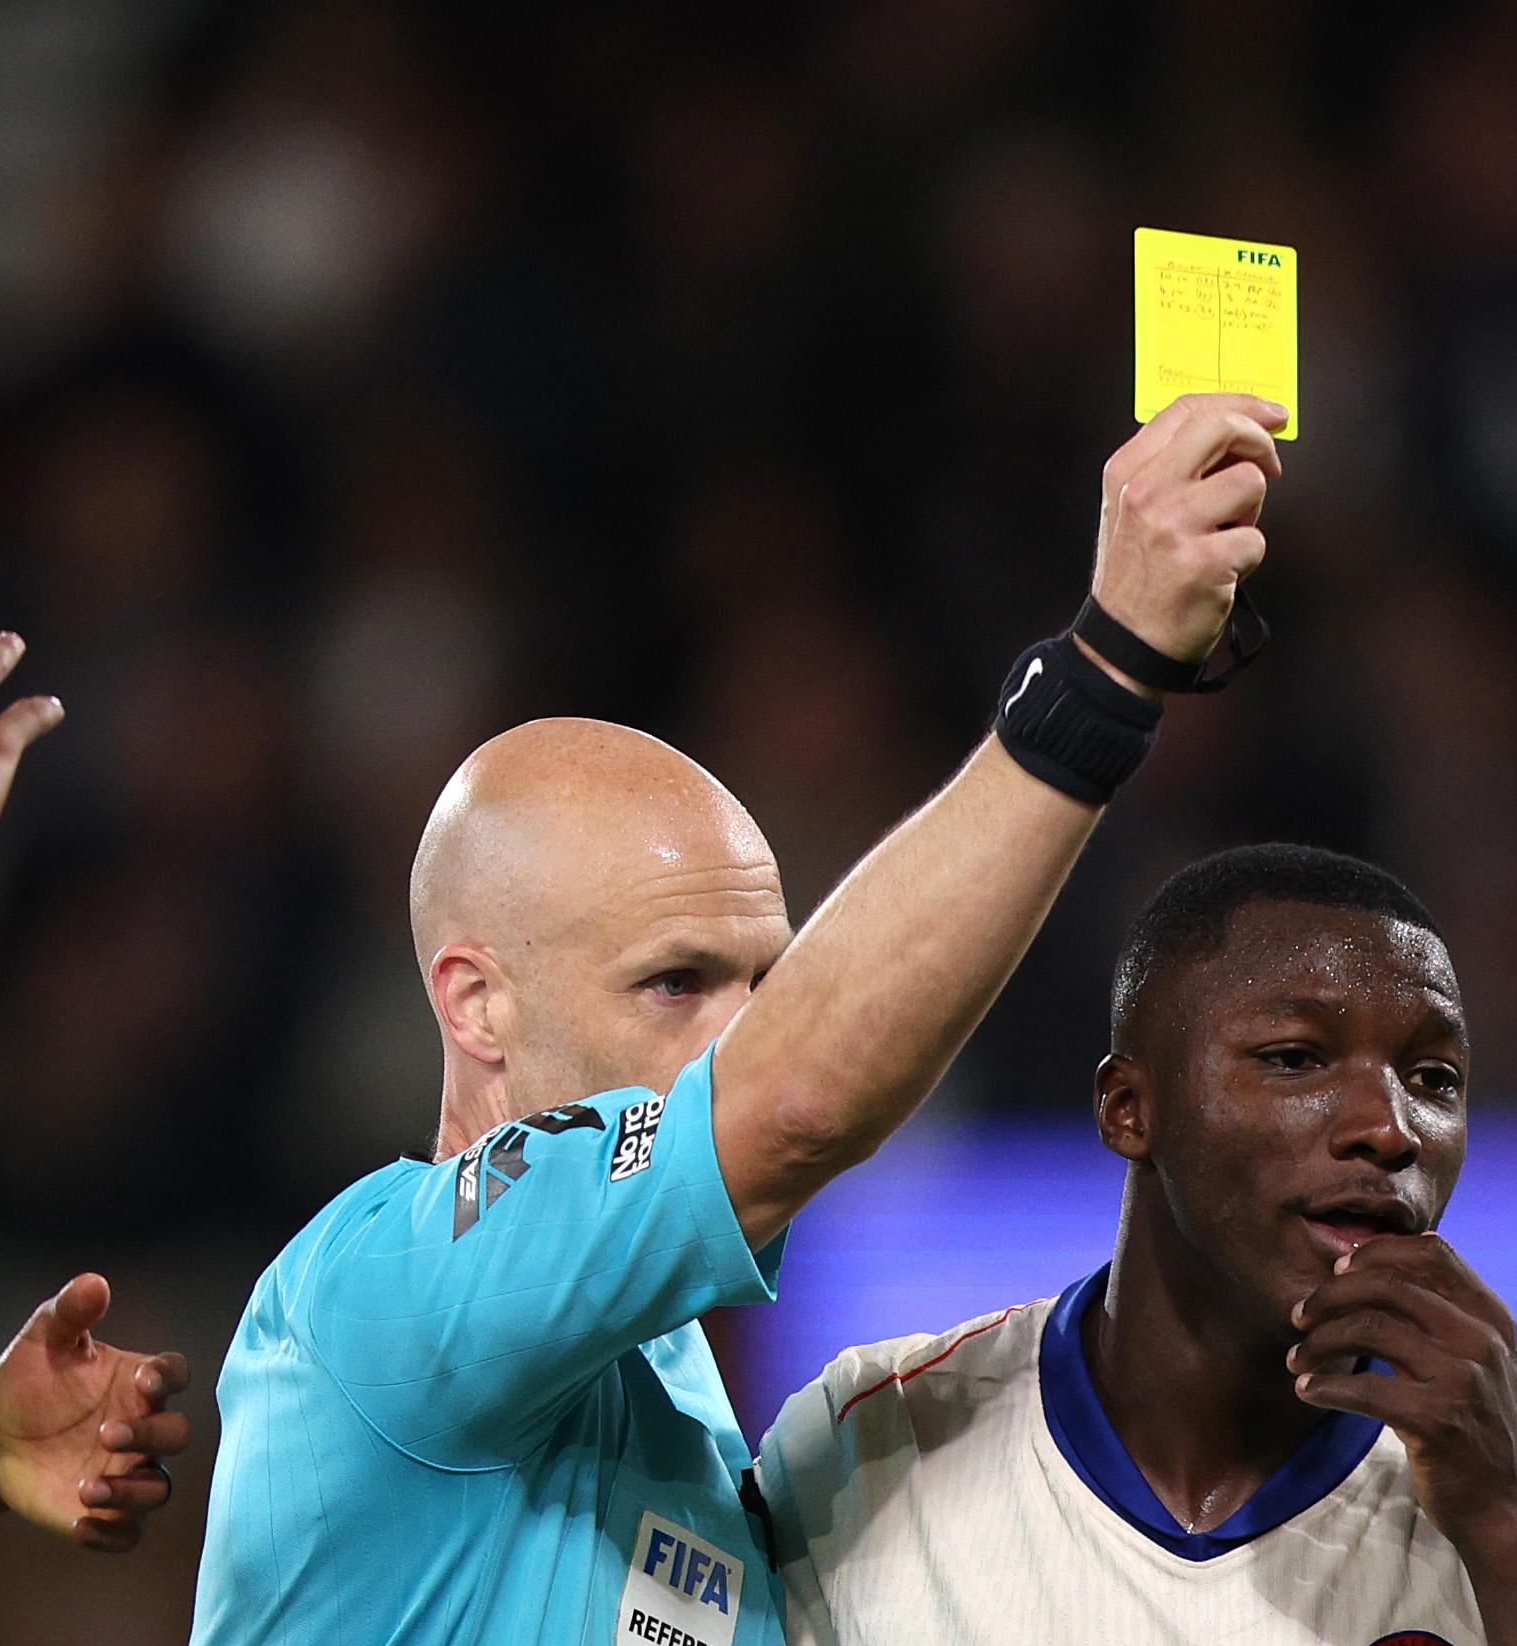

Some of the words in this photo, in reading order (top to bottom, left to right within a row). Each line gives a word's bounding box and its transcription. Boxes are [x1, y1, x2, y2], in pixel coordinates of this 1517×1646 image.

[1237, 249, 1281, 267] FIFA
[610, 1136, 639, 1182] No
[642, 1527, 729, 1615] FIFA
